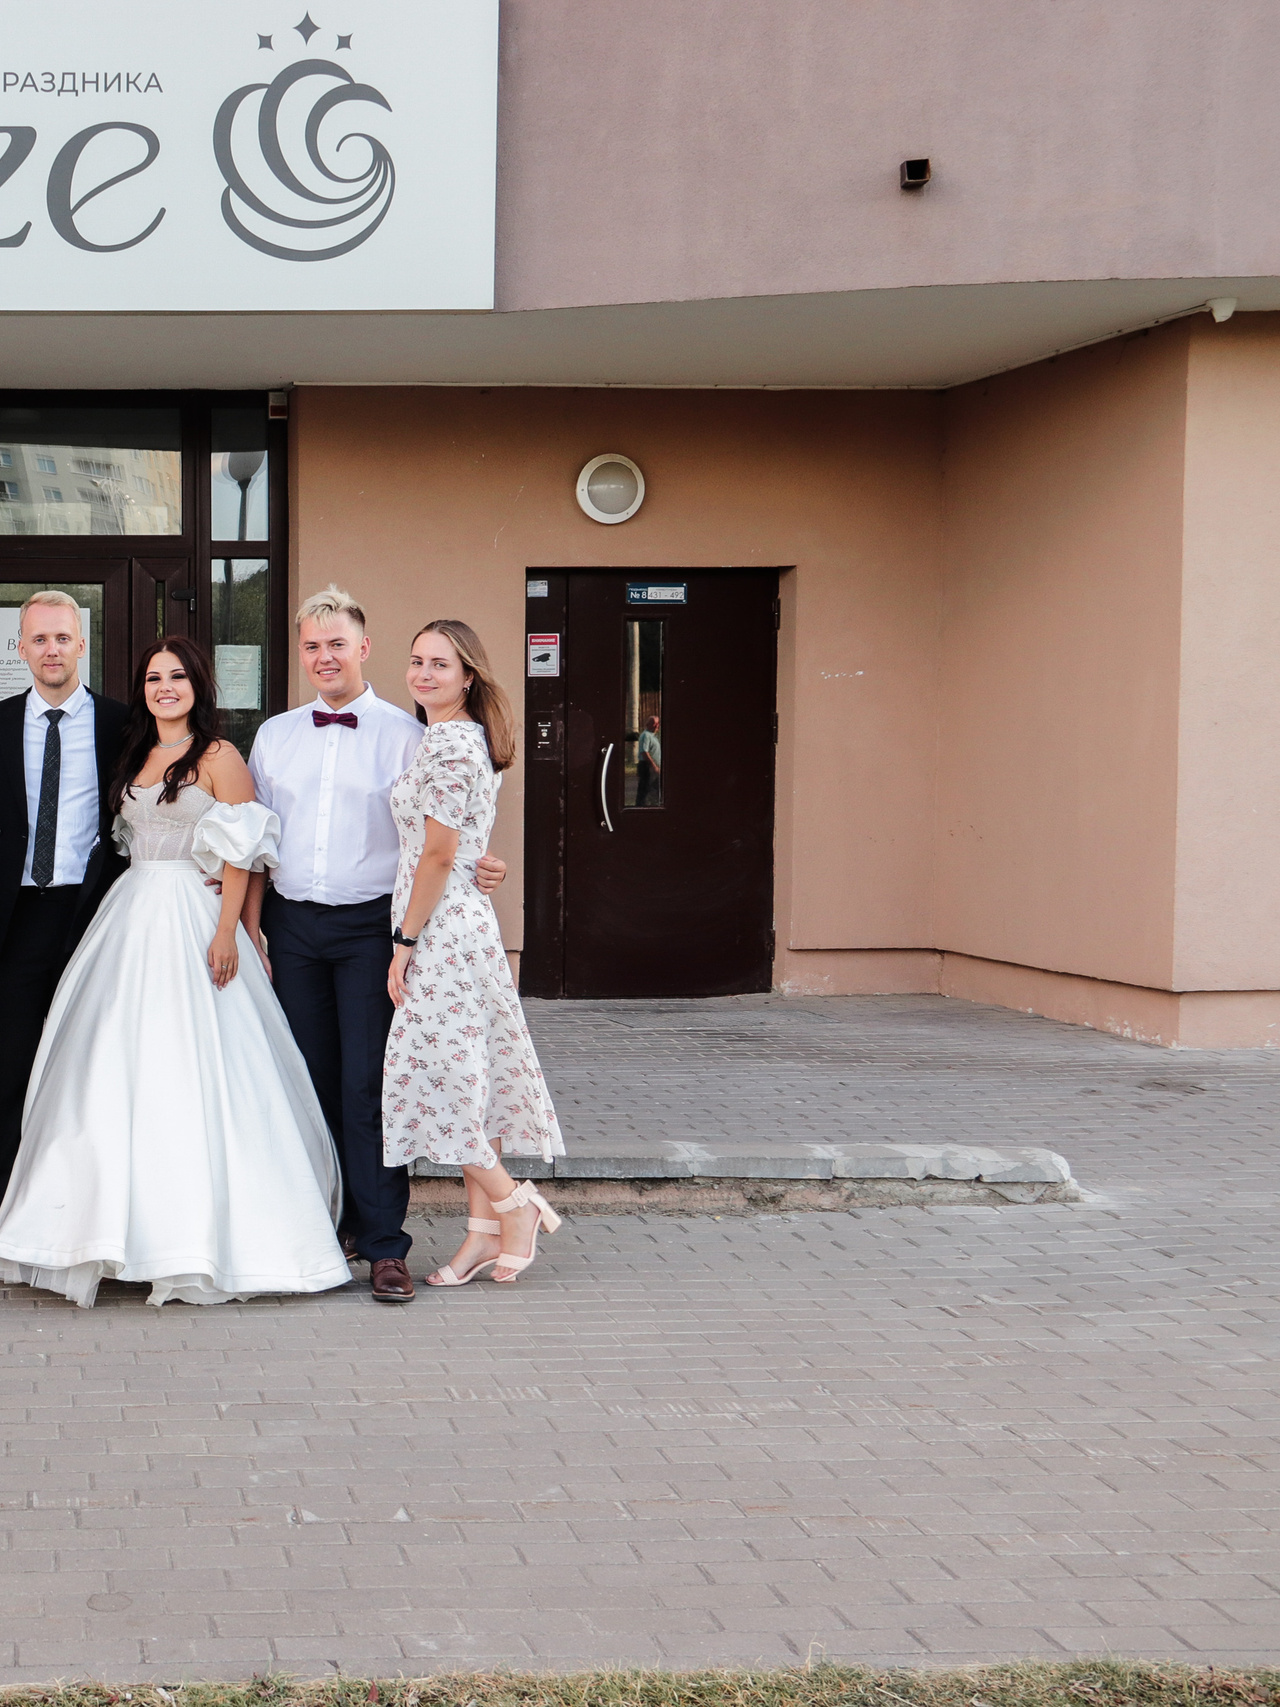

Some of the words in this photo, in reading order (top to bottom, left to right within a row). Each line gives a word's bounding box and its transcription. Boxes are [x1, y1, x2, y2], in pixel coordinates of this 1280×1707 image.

[630, 591, 641, 599] №
[641, 591, 647, 599] 8
[648, 591, 662, 599] 431
[669, 591, 684, 599] 492
